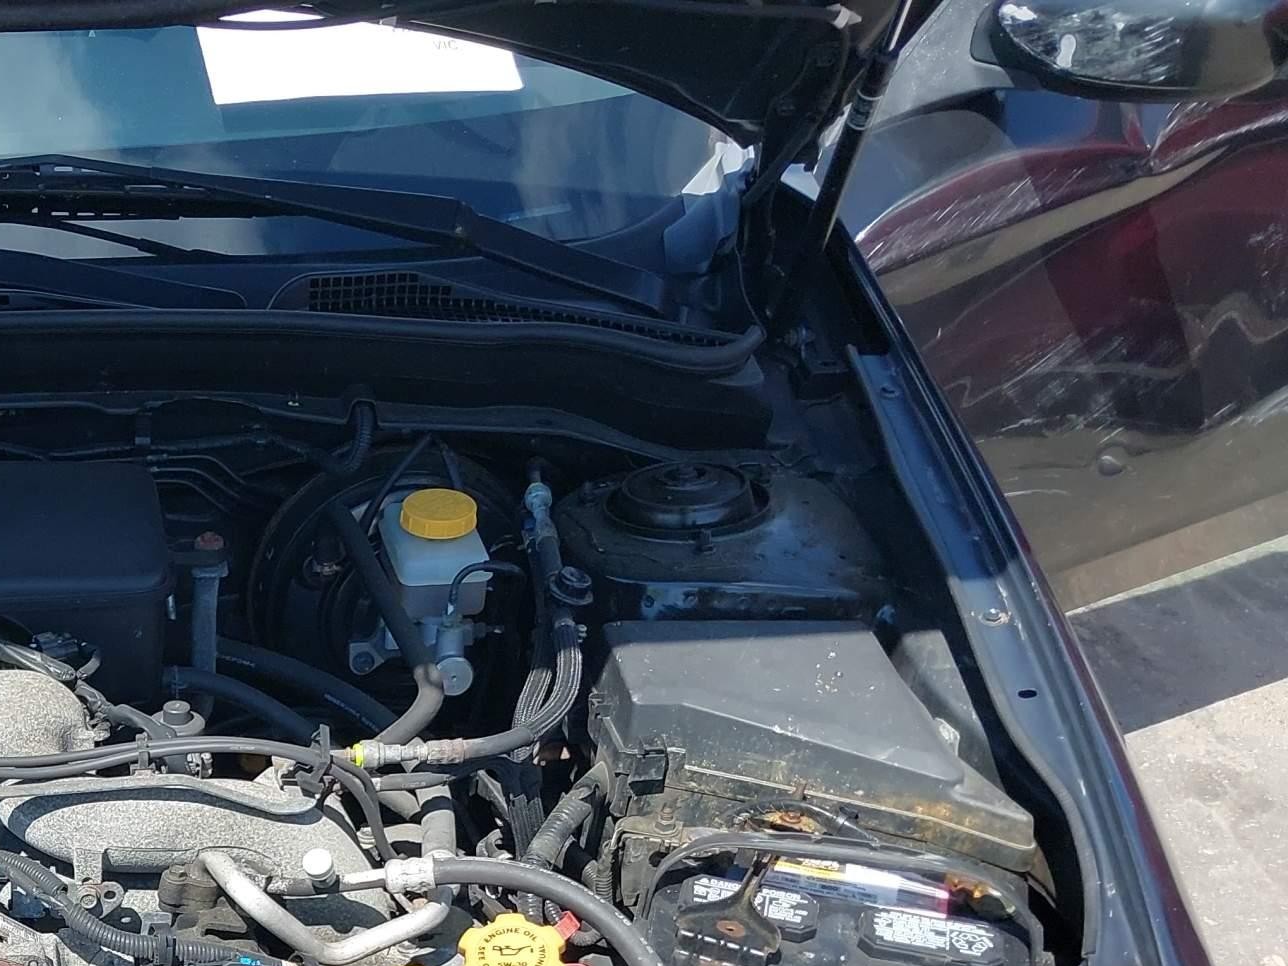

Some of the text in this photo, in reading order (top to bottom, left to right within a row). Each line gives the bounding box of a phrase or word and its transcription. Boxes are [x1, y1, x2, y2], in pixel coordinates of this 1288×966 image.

[484, 927, 538, 944] ENGINE OIL
[477, 945, 486, 961] SEE
